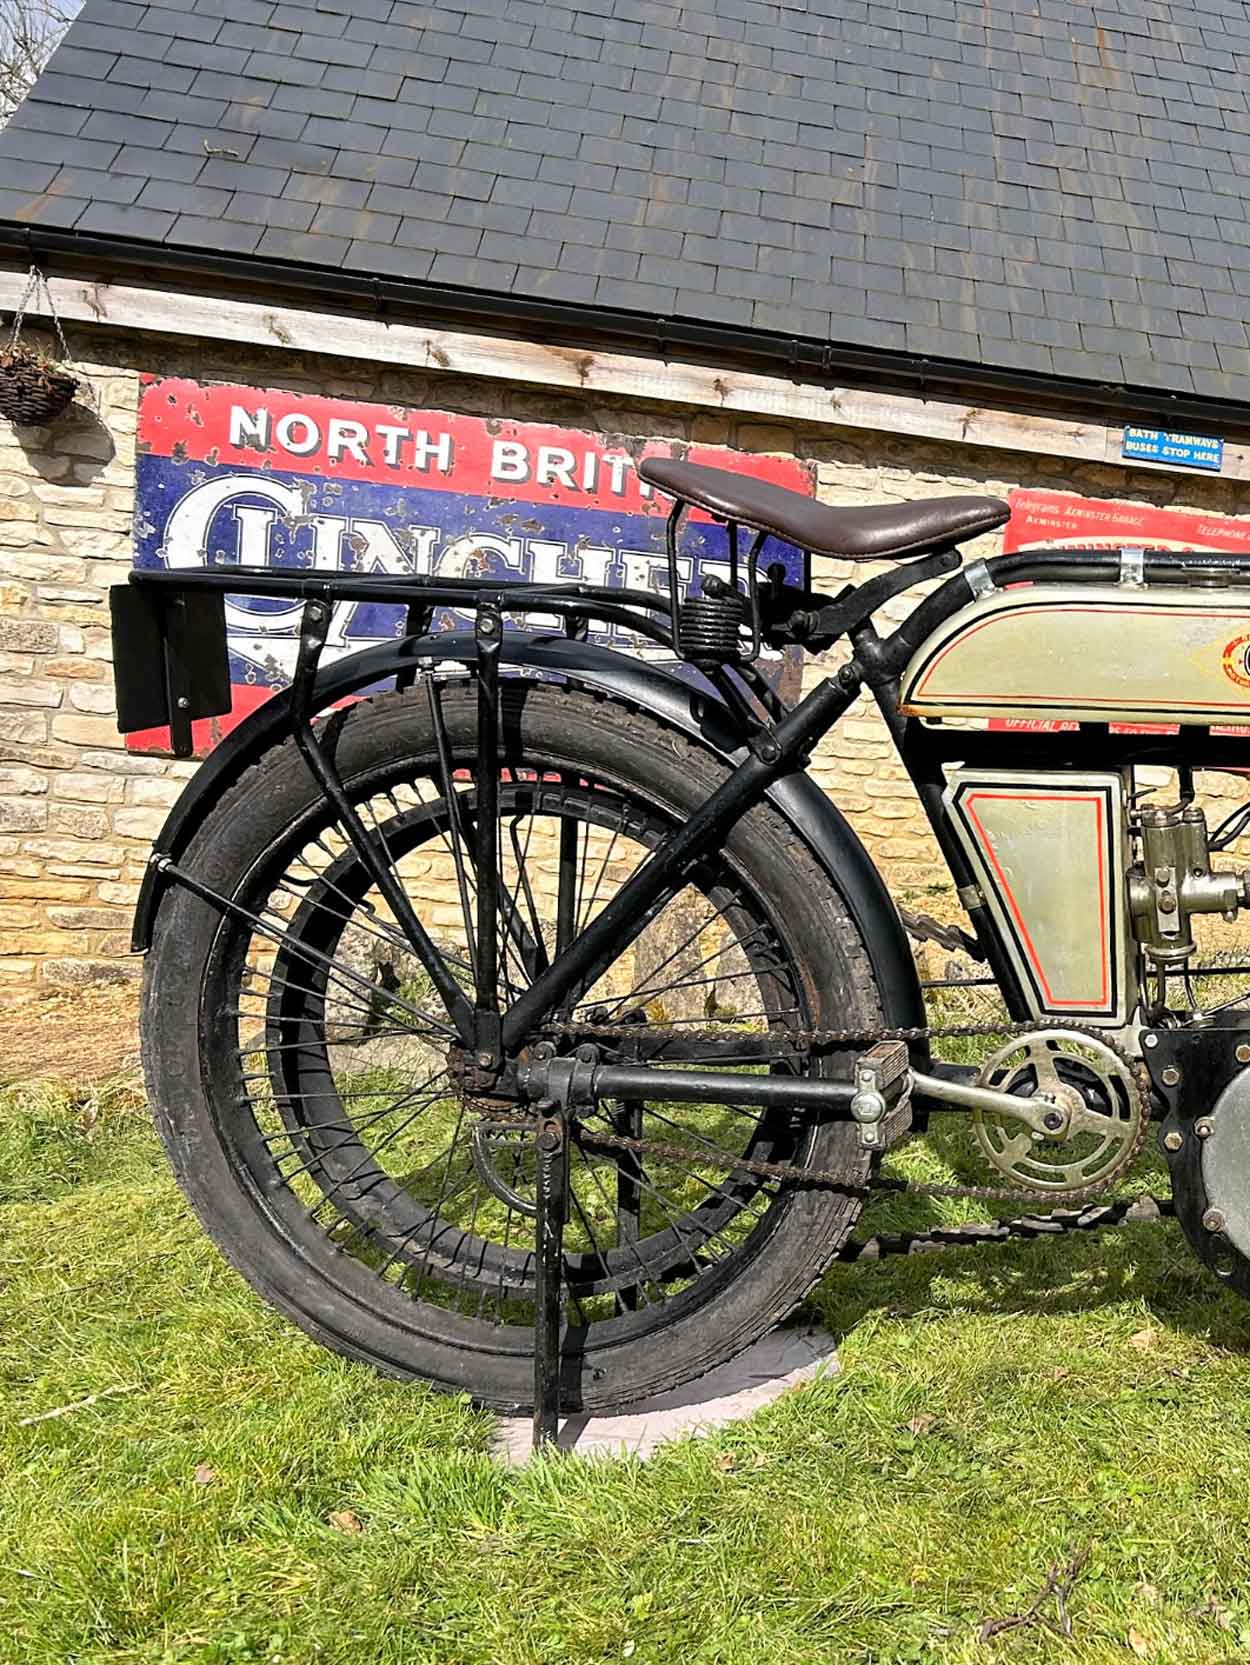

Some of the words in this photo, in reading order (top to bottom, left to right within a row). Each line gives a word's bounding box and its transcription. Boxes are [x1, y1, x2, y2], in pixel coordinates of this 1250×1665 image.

[1129, 428, 1158, 440] BATH
[1164, 432, 1219, 449] TRAMWAYS
[229, 405, 456, 475] NORTH
[490, 439, 675, 501] BRIT
[1125, 441, 1158, 454] BUSES
[1162, 446, 1191, 459] STOP
[1193, 450, 1220, 464] HERE
